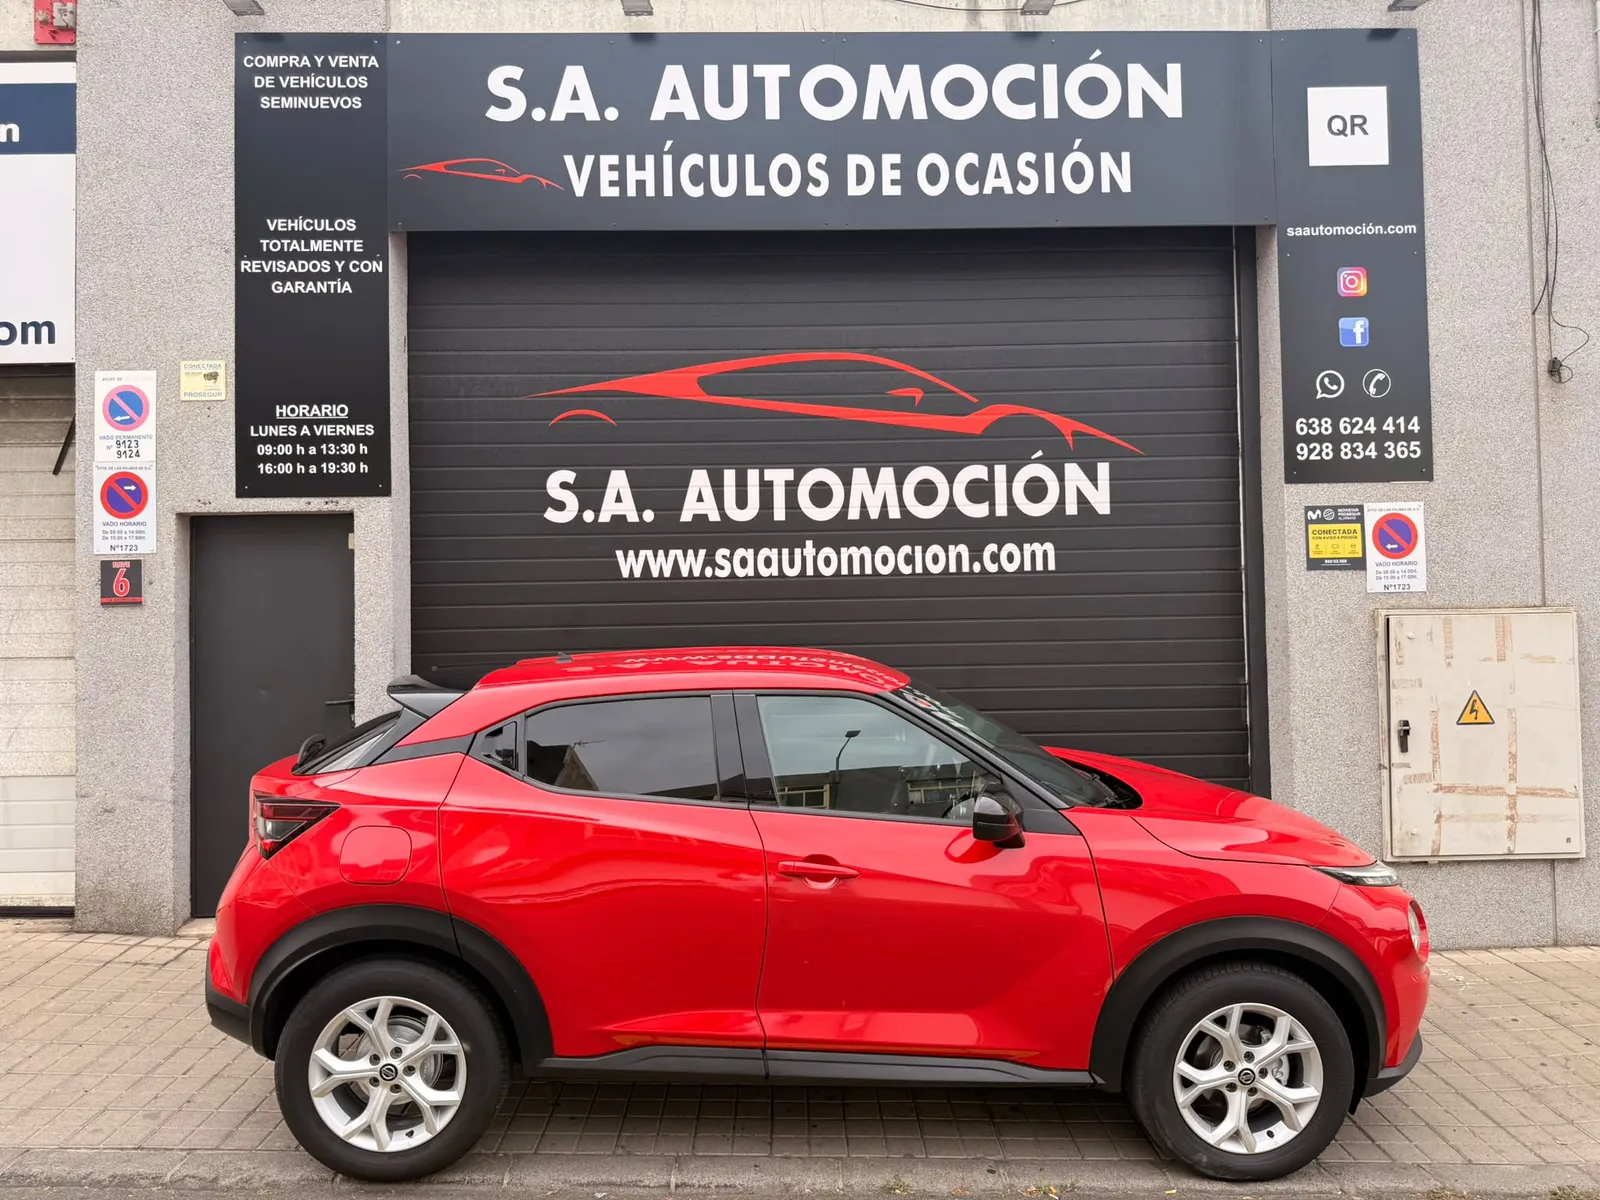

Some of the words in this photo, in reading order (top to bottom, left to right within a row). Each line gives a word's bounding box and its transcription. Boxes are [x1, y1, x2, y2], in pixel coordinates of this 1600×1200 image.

[243, 55, 311, 68] COMPRA
[314, 56, 324, 68] Y
[328, 55, 379, 68] VENTA
[255, 75, 275, 88] DE
[279, 72, 368, 88] VEHÍCULOS
[485, 65, 618, 121] S.A.
[650, 49, 1182, 121] AUTOMOCIÓN
[260, 96, 362, 109] SEMINUEVOS
[1327, 115, 1369, 138] QR
[564, 140, 829, 197] VEHÍCULOS
[847, 154, 901, 196] DE
[917, 139, 1131, 196] OCASIÓN
[266, 215, 357, 232] VEHÍCULOS
[1286, 222, 1417, 237] saautomoción.com
[260, 239, 363, 252] TOTALMENTE
[241, 260, 330, 273] REVISADOS
[335, 260, 345, 273] Y
[349, 260, 383, 273] CON
[271, 277, 353, 294] GARANTÍA
[276, 403, 349, 418] HORARIO
[250, 424, 297, 437] LUNES
[300, 424, 310, 437] A
[314, 423, 374, 437] VIERNES
[1295, 417, 1333, 436] 638
[1339, 416, 1377, 435] 624
[1382, 415, 1421, 434] 414
[116, 440, 139, 449] 9123
[257, 443, 293, 456] 09:00
[297, 443, 304, 456] h
[308, 445, 317, 456] a
[321, 442, 356, 455] 13:30
[360, 443, 368, 455] h
[1296, 442, 1333, 461] 928
[1340, 441, 1378, 460] 834
[1383, 440, 1421, 459] 365
[117, 449, 140, 459] 9124
[257, 462, 293, 475] 16:00
[296, 462, 304, 474] h
[308, 464, 317, 475] a
[321, 461, 356, 474] 19:30
[360, 461, 368, 474] h
[543, 469, 655, 523] S.A.
[679, 449, 1111, 522] AUTOMOCIÓN
[615, 540, 1056, 578] www.saautomocion.com
[113, 568, 130, 597] 6
